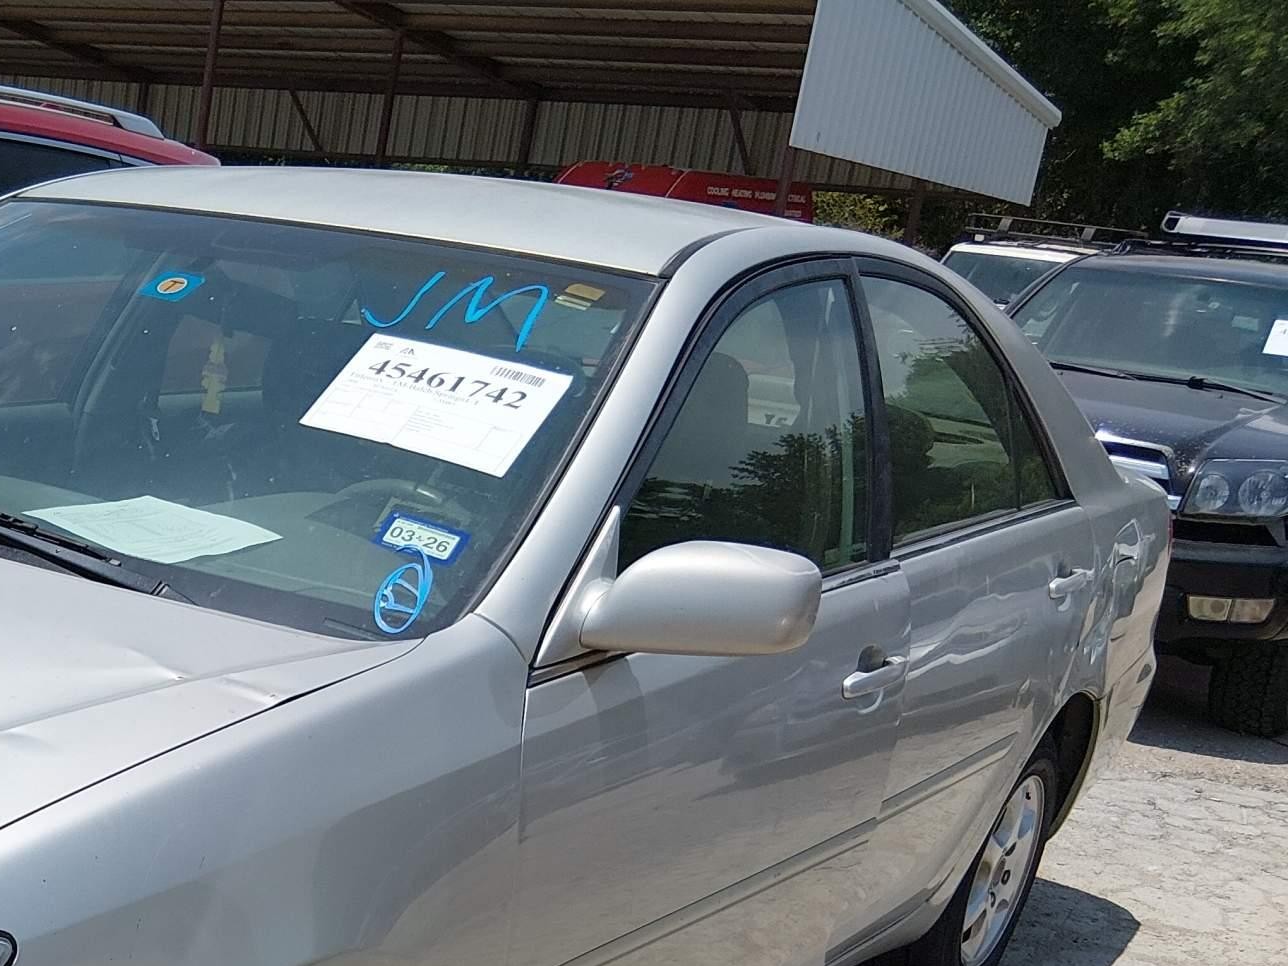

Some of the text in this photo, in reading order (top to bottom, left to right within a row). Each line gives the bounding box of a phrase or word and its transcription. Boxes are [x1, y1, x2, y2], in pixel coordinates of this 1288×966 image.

[368, 359, 528, 410] 45461742
[389, 526, 415, 542] 03
[422, 536, 450, 553] 26
